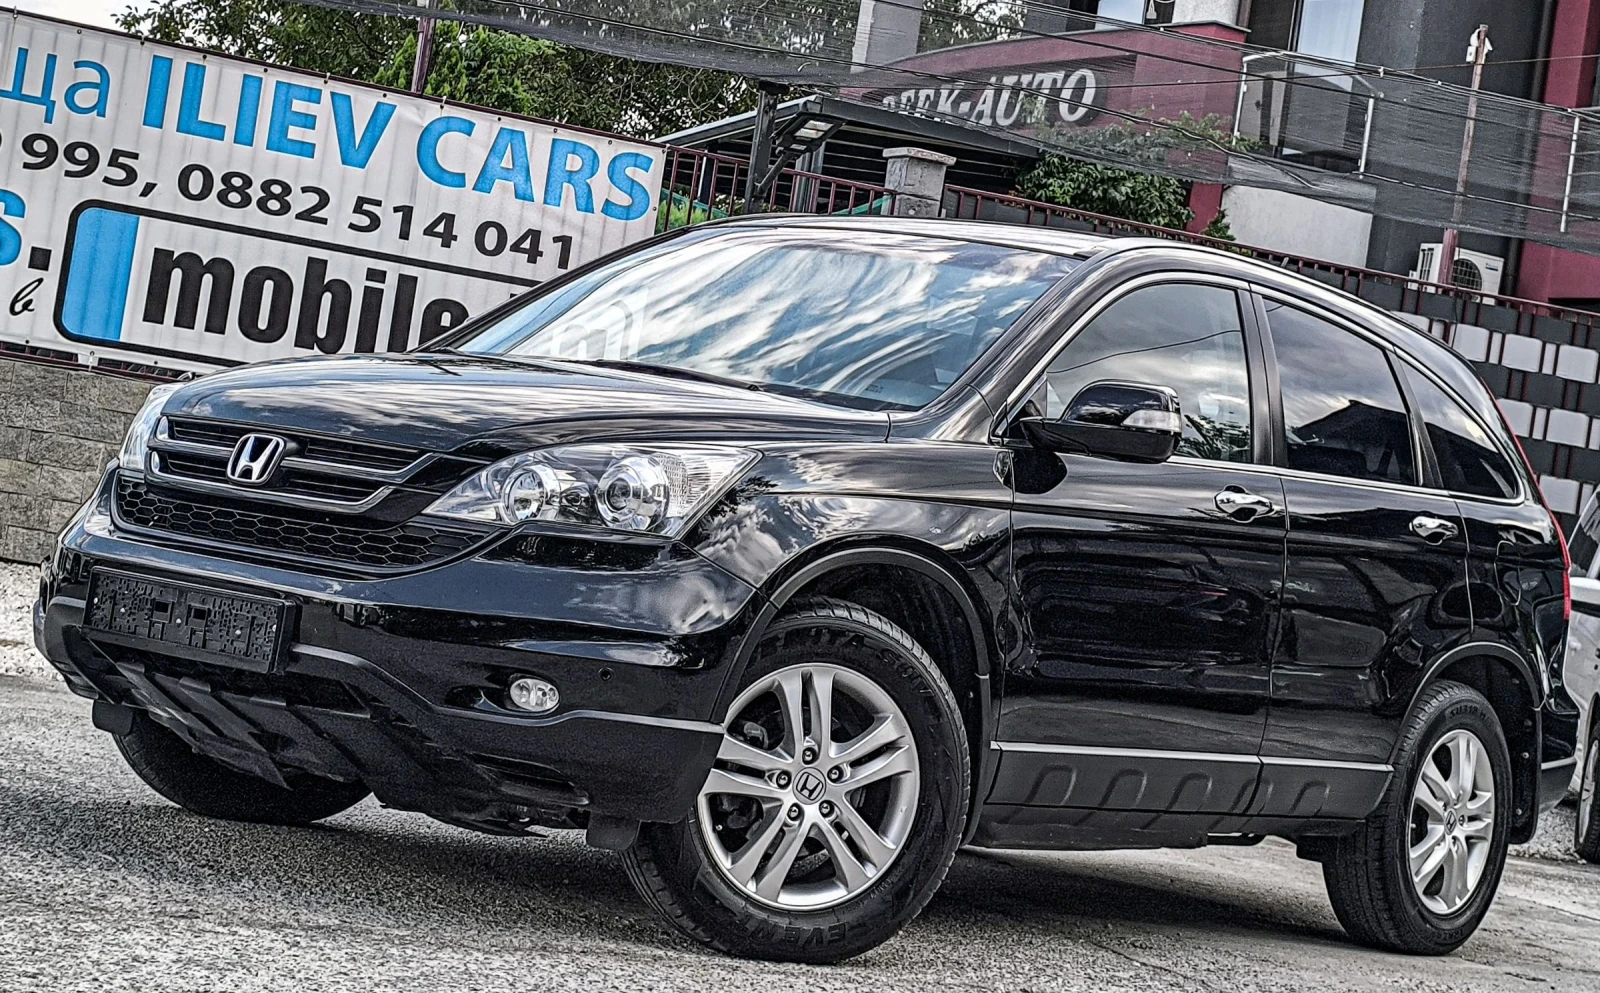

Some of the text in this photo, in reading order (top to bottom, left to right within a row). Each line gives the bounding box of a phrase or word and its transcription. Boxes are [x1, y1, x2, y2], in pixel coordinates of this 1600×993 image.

[21, 133, 573, 270] 995, 0882 514 041
[143, 55, 397, 169] ILIEV
[417, 116, 654, 221] CARS
